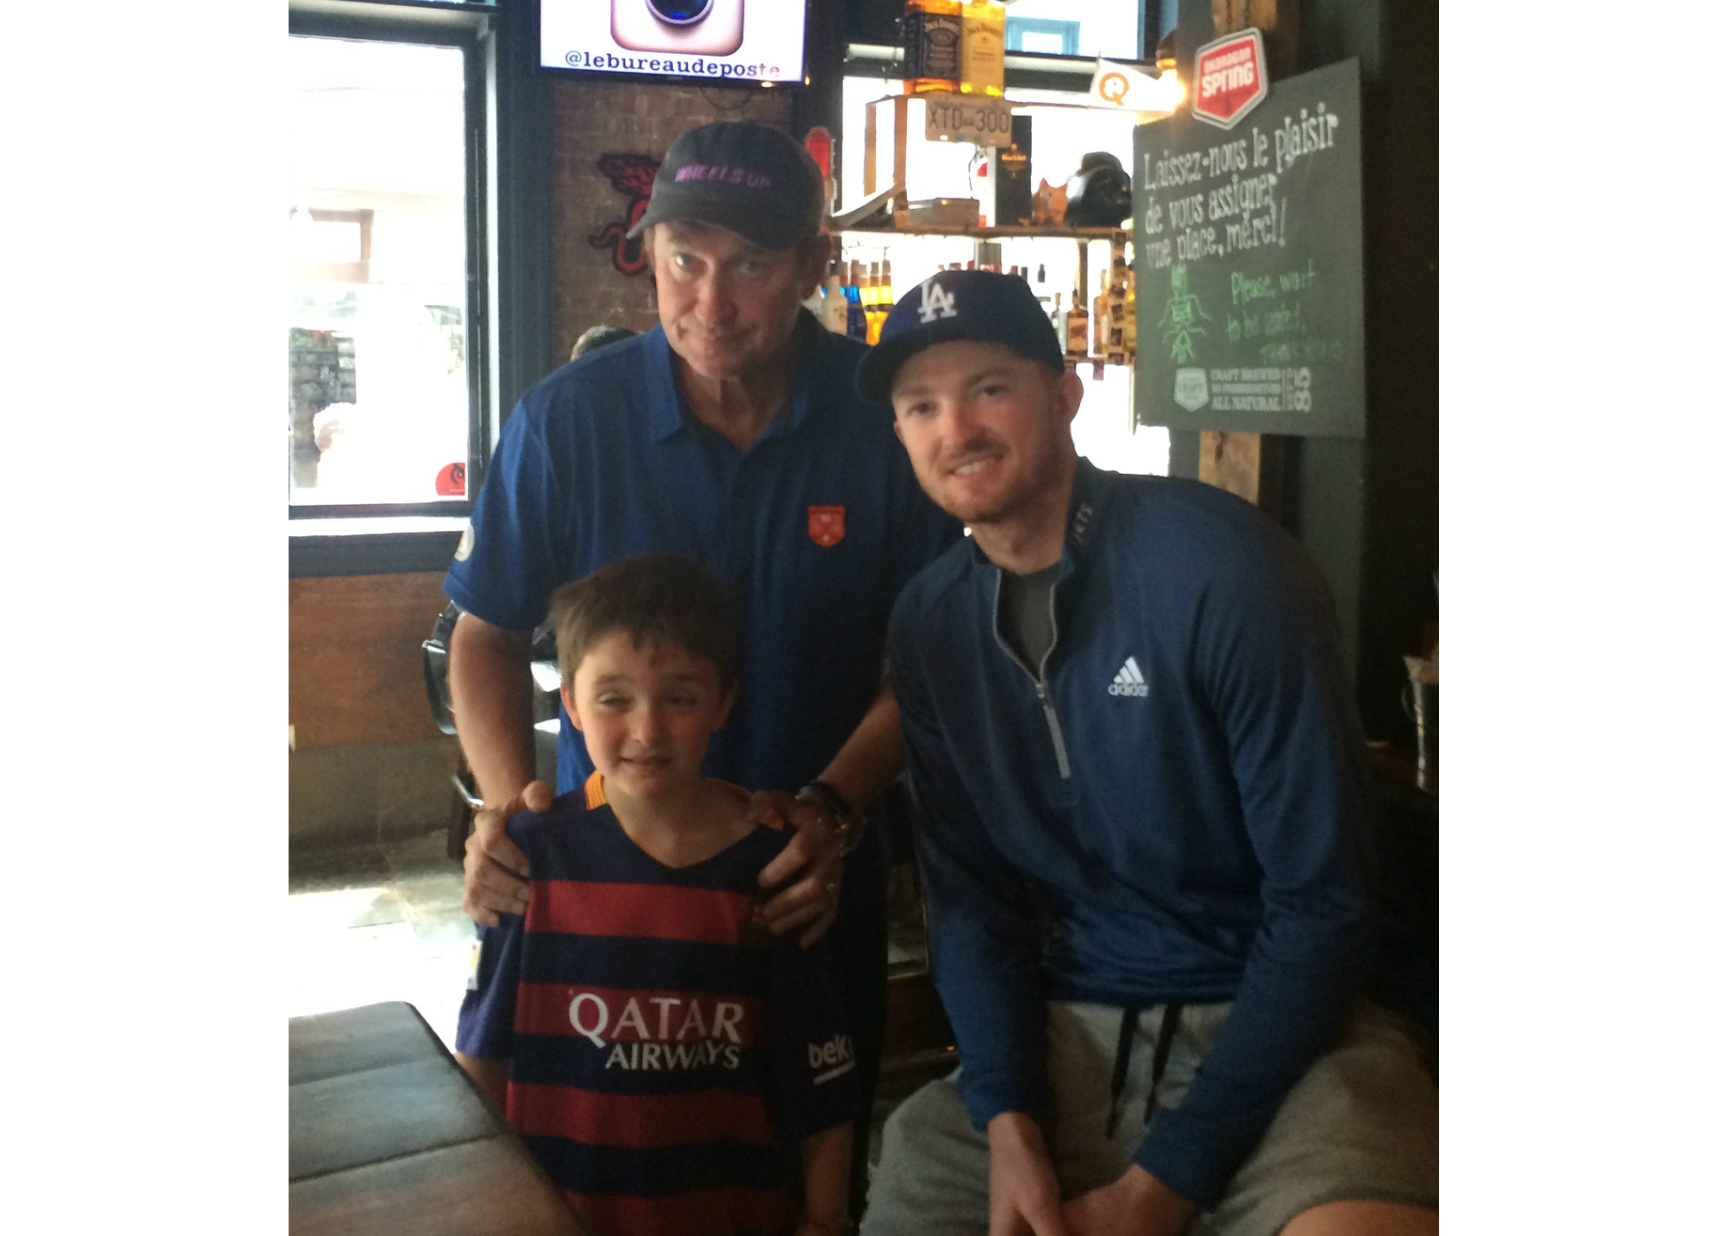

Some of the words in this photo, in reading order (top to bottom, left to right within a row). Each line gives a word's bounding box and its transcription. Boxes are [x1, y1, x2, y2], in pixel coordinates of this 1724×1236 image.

[565, 50, 780, 78] @lebureaudeposte
[1099, 72, 1131, 106] Q
[928, 103, 1009, 134] XTD-300
[1143, 138, 1248, 191] Laissez-nous
[1252, 127, 1269, 168] le
[1274, 101, 1339, 175] plaisir
[1145, 196, 1164, 235] de
[1168, 193, 1205, 231] vous
[1207, 173, 1278, 222] assigner
[1145, 237, 1172, 269] une
[916, 278, 959, 324] LA
[1107, 683, 1149, 698] adidas
[568, 992, 742, 1049] QATAR
[605, 1040, 741, 1071] AIRWAYS
